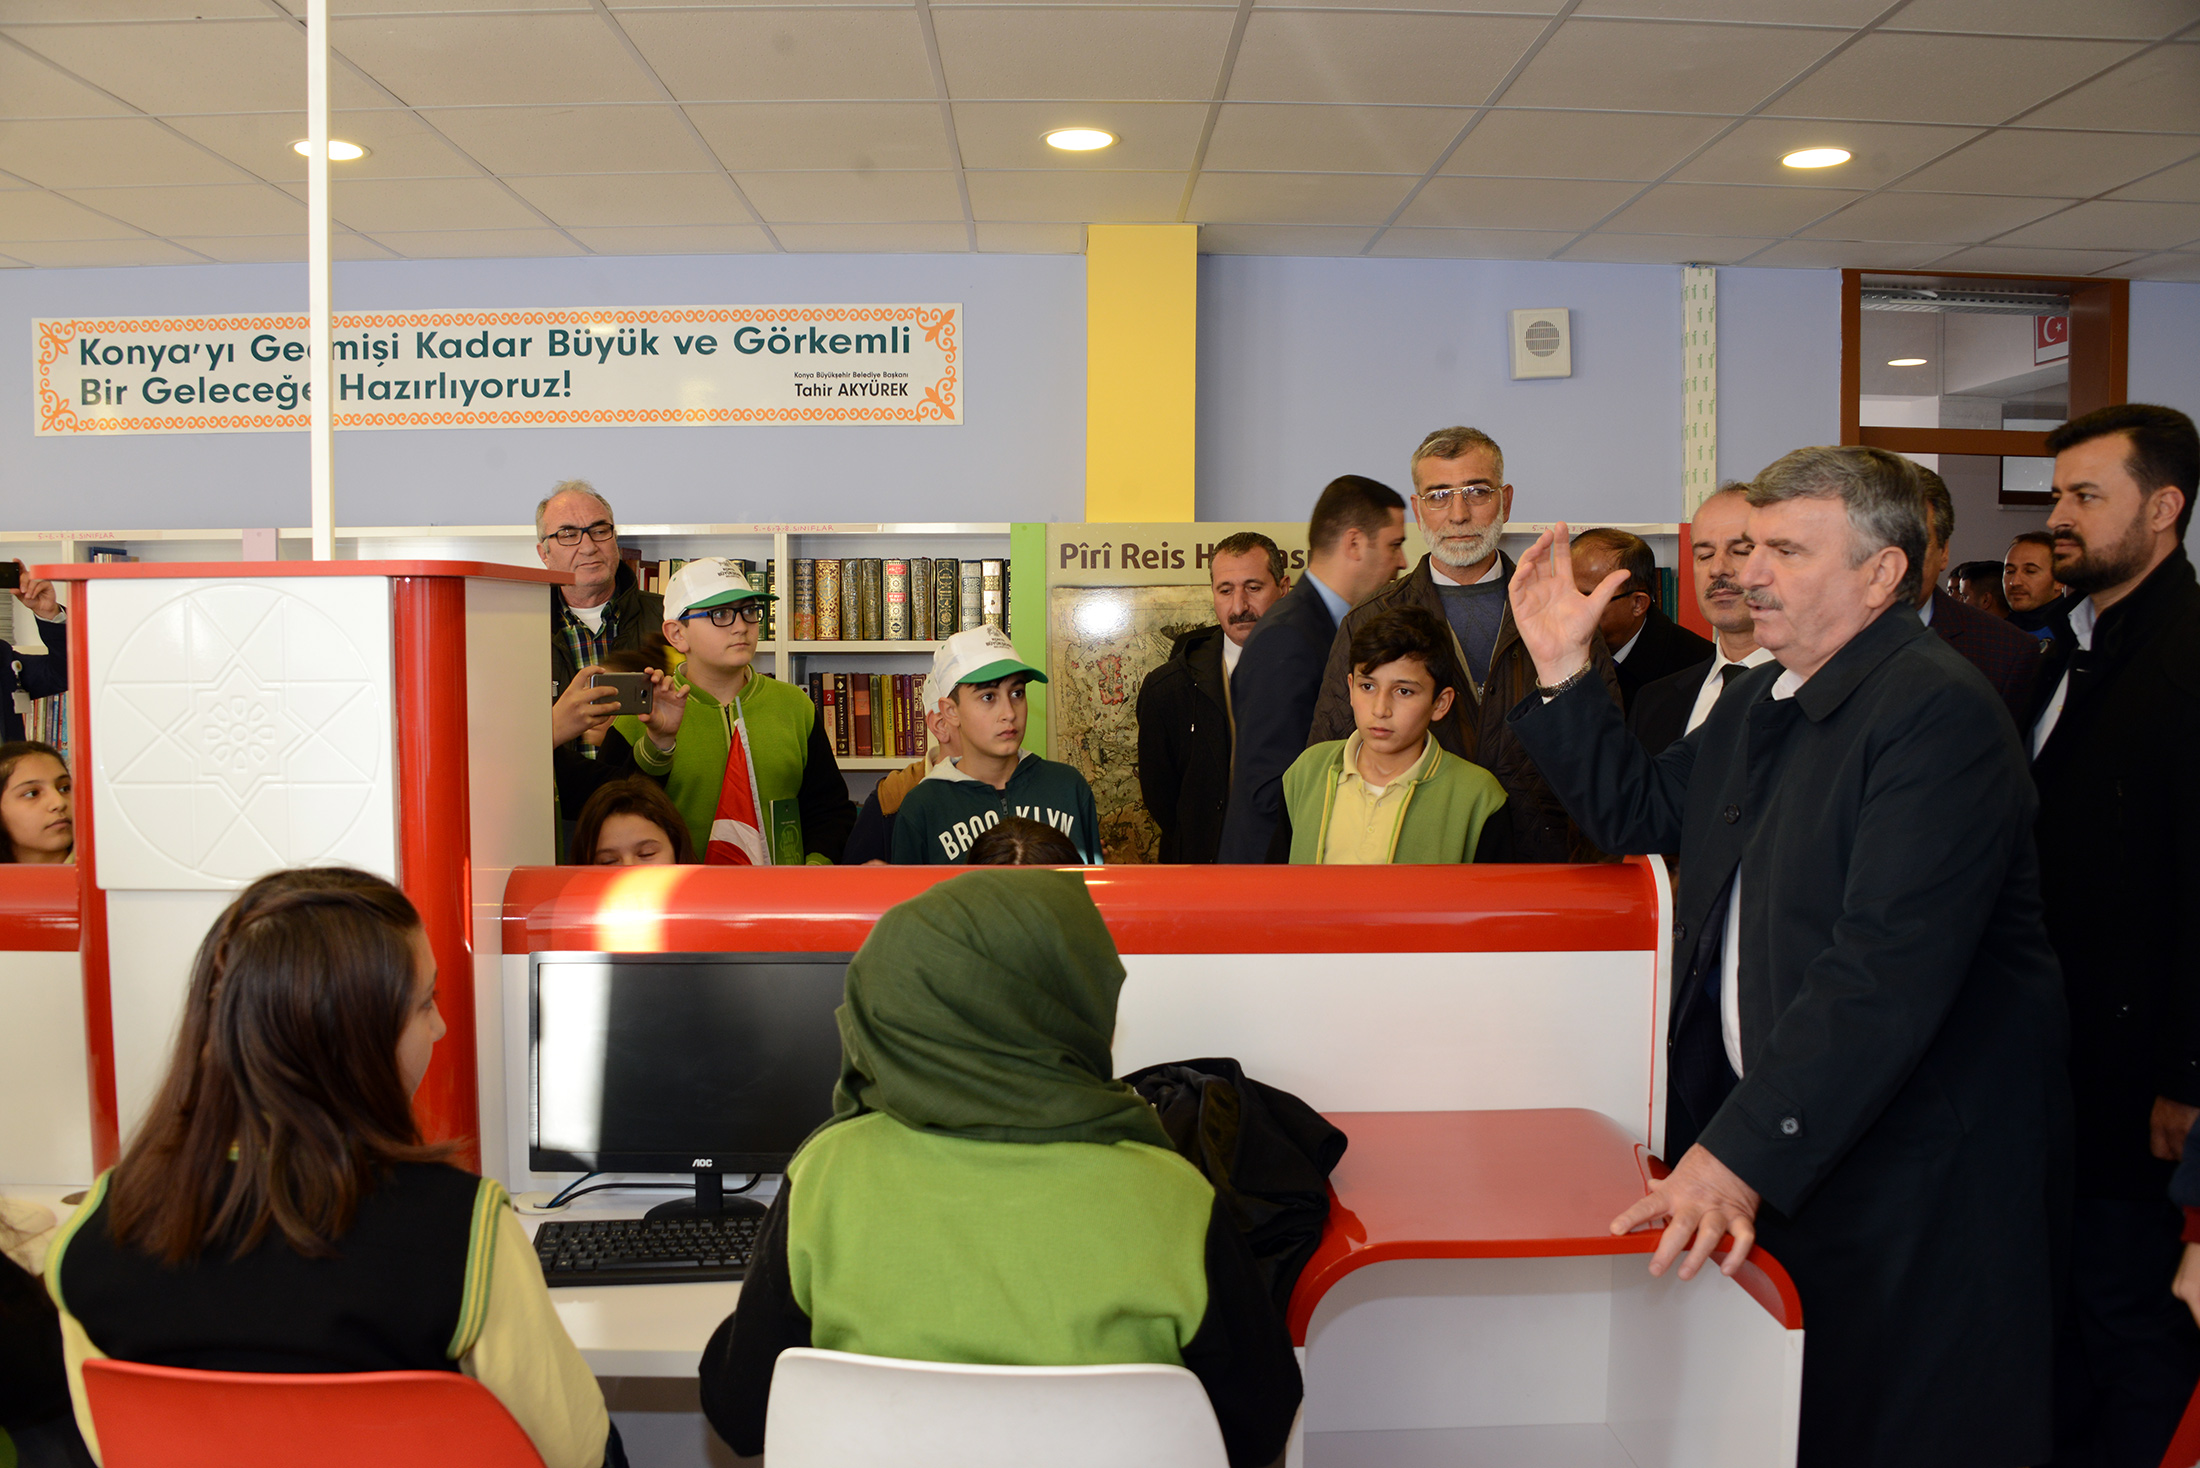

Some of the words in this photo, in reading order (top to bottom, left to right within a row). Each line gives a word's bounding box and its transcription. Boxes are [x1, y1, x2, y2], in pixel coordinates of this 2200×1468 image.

[79, 338, 235, 373] Konya'yı
[250, 332, 399, 368] Gemişi
[415, 330, 532, 360] Kadar
[548, 328, 659, 365] Büyük
[673, 335, 718, 355] ve
[733, 326, 910, 355] Görkemli
[793, 371, 814, 379] Konya
[816, 371, 851, 379] Büyükşehir
[852, 371, 881, 379] Belediye
[882, 371, 908, 379] Başkanı
[80, 377, 128, 406] Bir
[340, 369, 571, 407] Hazırlıyoruz!
[794, 383, 833, 397] Tahir
[837, 379, 909, 397] AKYÜREK
[1060, 541, 1112, 570] Pîrî
[1121, 541, 1185, 570] Reis
[1195, 543, 1313, 570] Hası
[826, 693, 832, 702] 2
[692, 1158, 713, 1168] AOC
